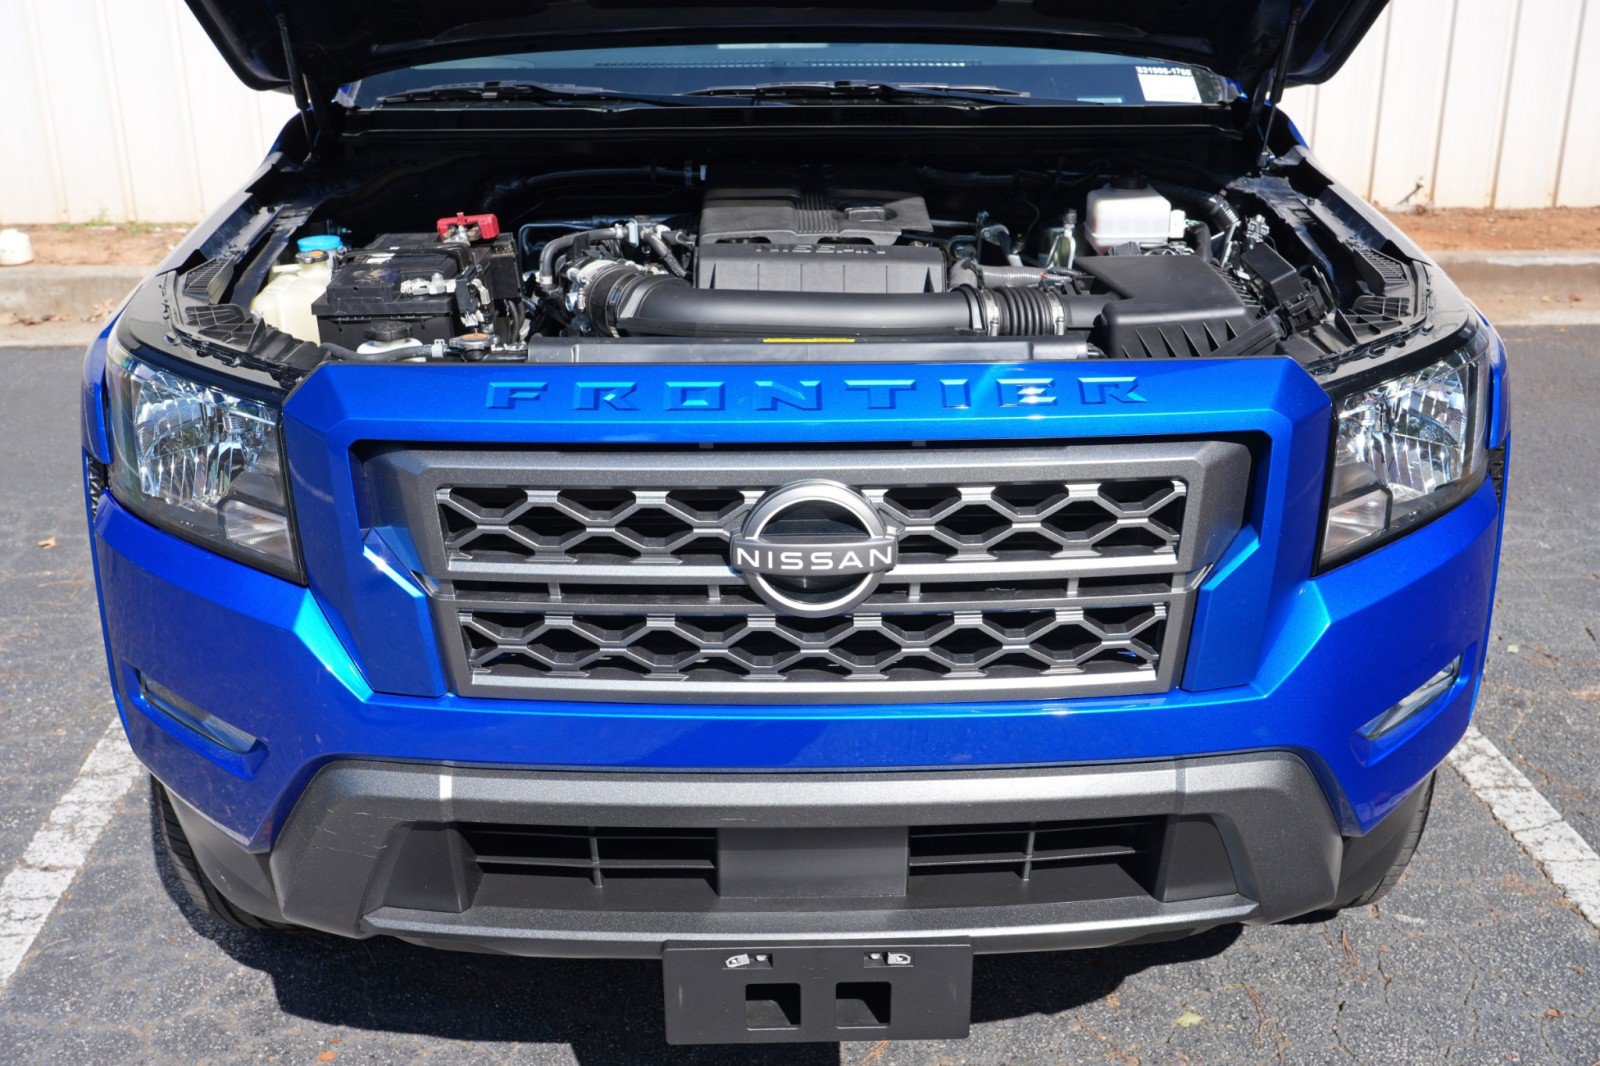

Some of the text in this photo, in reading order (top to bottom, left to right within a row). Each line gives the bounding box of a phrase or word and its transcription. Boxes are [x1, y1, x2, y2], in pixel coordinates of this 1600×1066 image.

[755, 243, 887, 254] NISSAN
[486, 377, 1148, 411] FRONTIER
[736, 546, 892, 570] NISSAN
